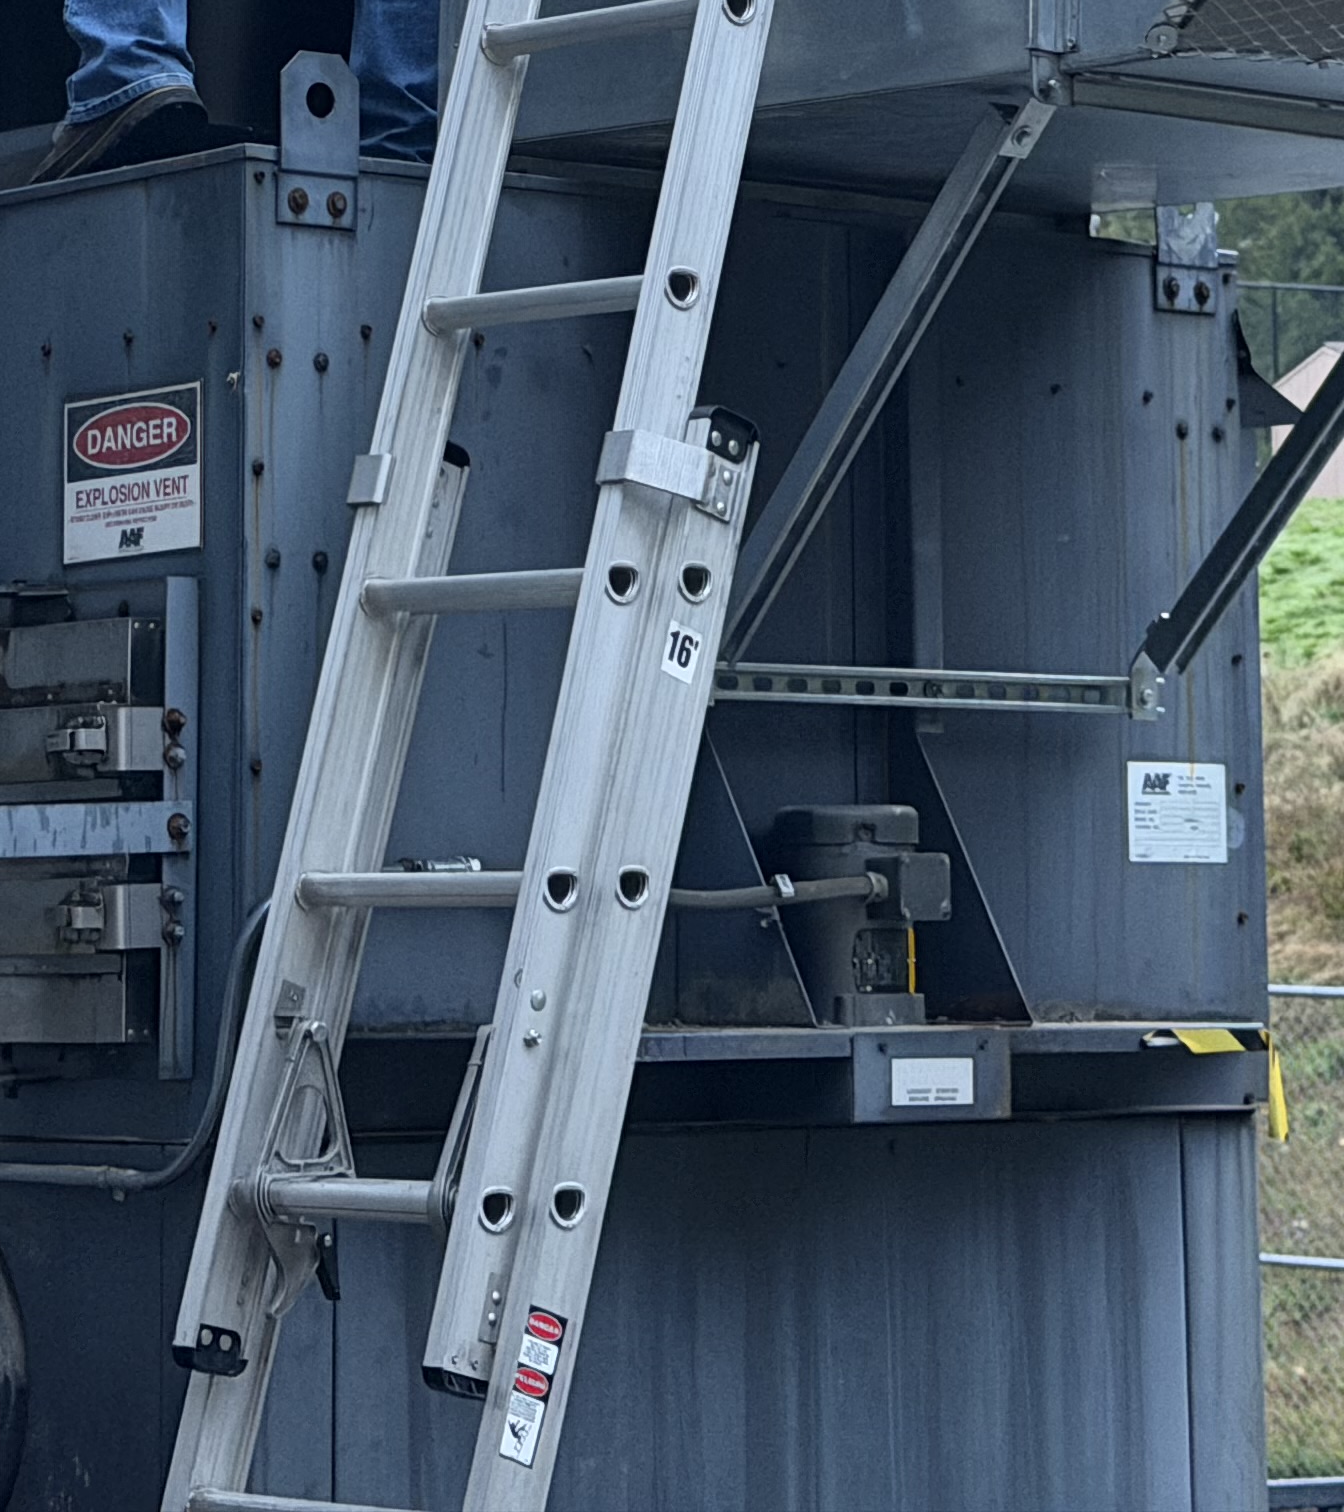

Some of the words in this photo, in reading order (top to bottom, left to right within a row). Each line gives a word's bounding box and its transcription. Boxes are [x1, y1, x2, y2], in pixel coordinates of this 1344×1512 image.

[87, 417, 177, 455] DANGER
[76, 480, 151, 508] EXPLOSION
[154, 475, 189, 498] VENT
[668, 630, 700, 669] 16'
